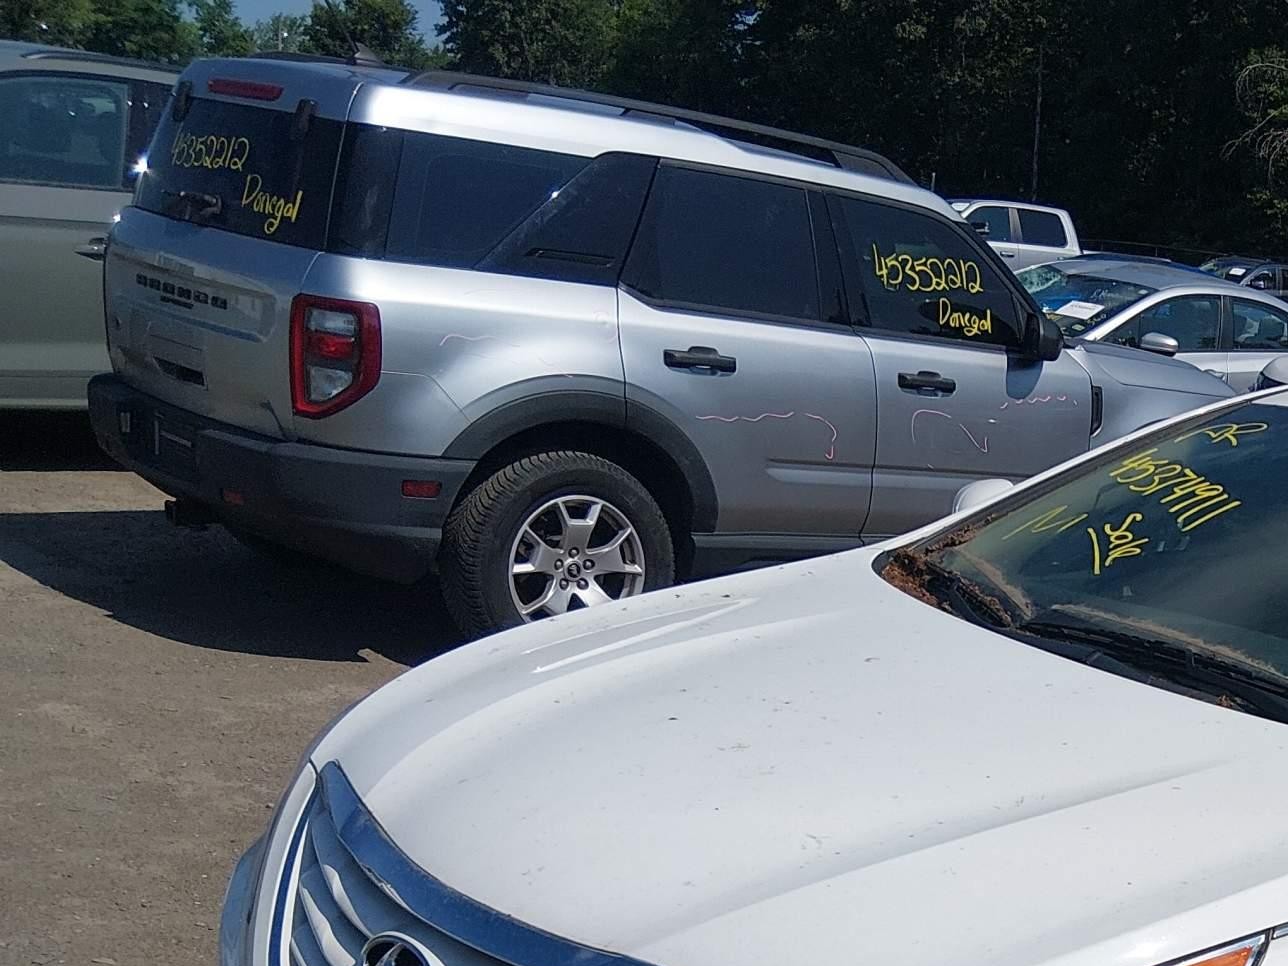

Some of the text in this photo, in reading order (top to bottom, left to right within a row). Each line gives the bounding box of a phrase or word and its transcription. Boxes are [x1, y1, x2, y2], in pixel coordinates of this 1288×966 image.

[171, 129, 249, 171] 45352212
[872, 243, 984, 293] 45352212
[1109, 447, 1242, 532] 45374911
